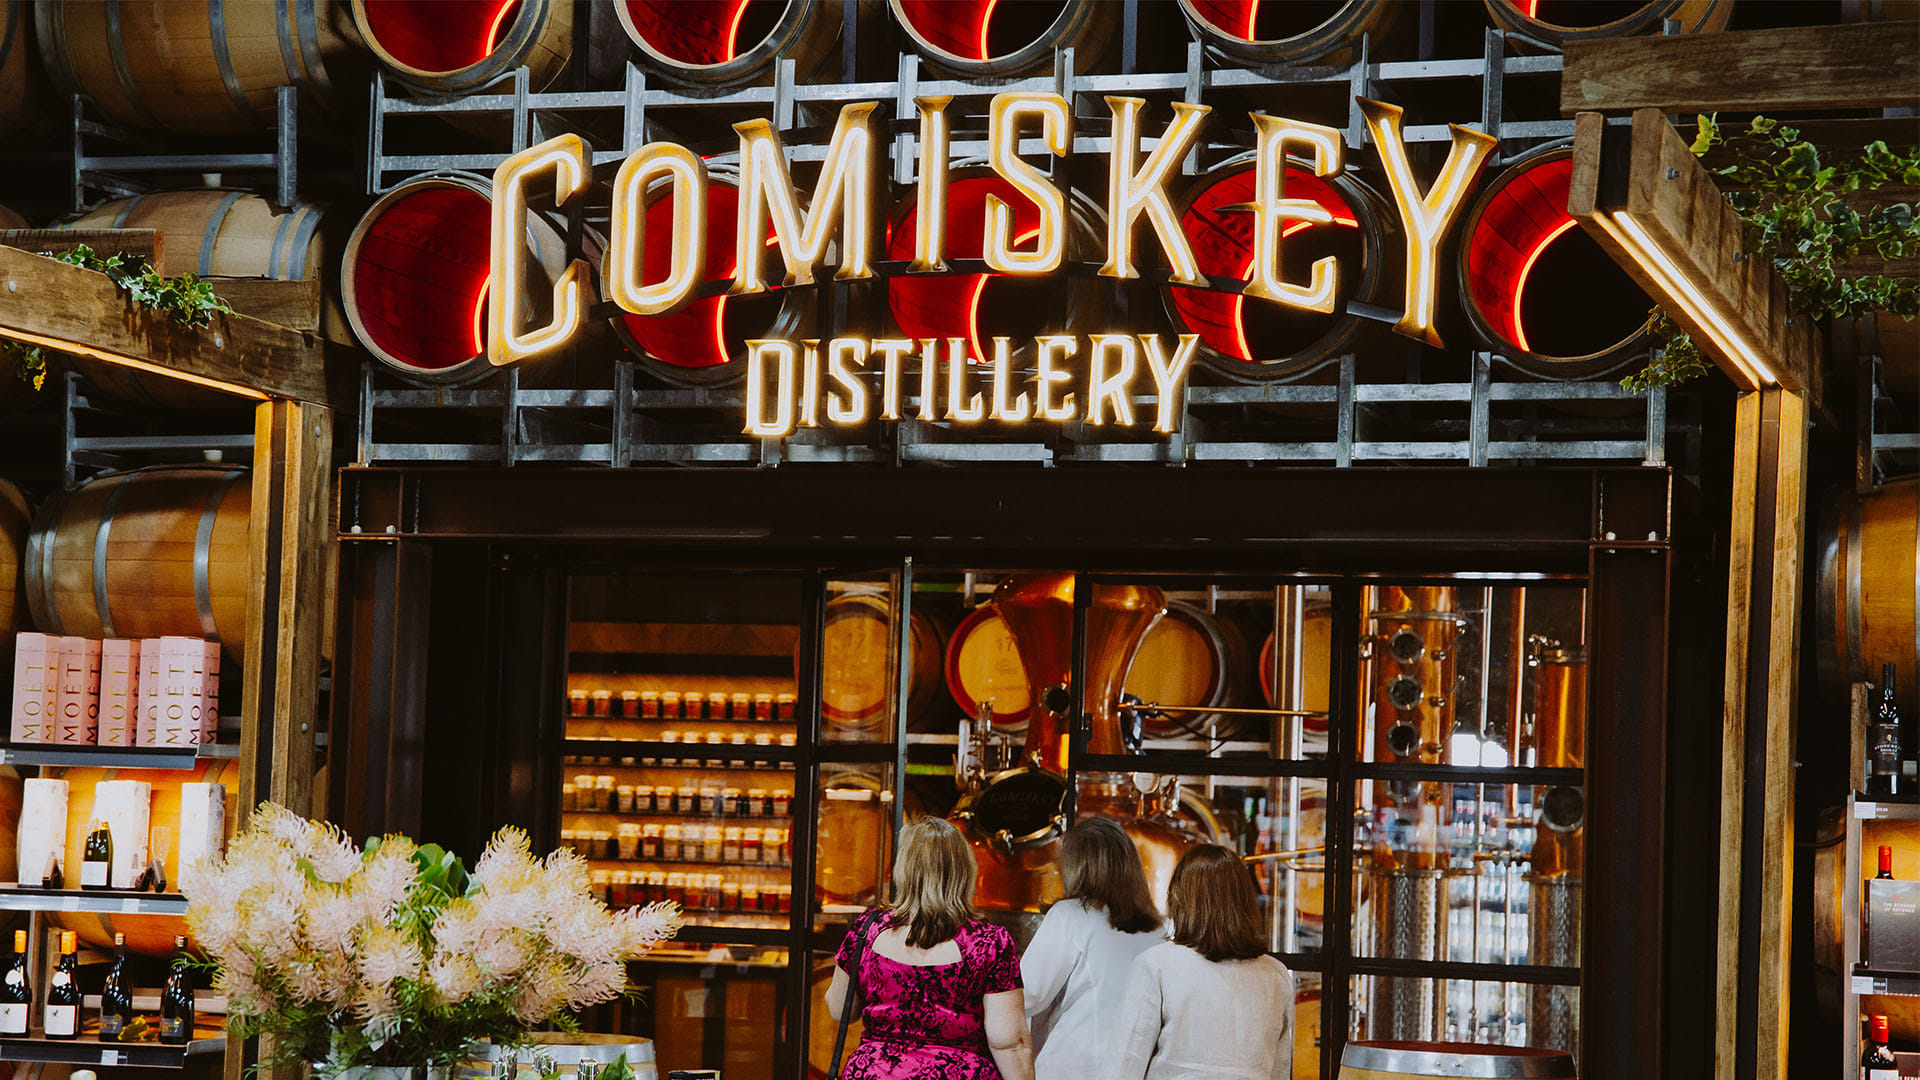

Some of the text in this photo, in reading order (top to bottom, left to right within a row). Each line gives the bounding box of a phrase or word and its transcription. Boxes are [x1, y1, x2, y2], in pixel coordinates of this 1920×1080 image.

[488, 92, 1498, 365] COMISKEY
[743, 334, 1200, 436] DISTILLERY
[63, 664, 82, 742] MOËT
[165, 664, 184, 744] MOËT
[189, 664, 202, 744] MOËT
